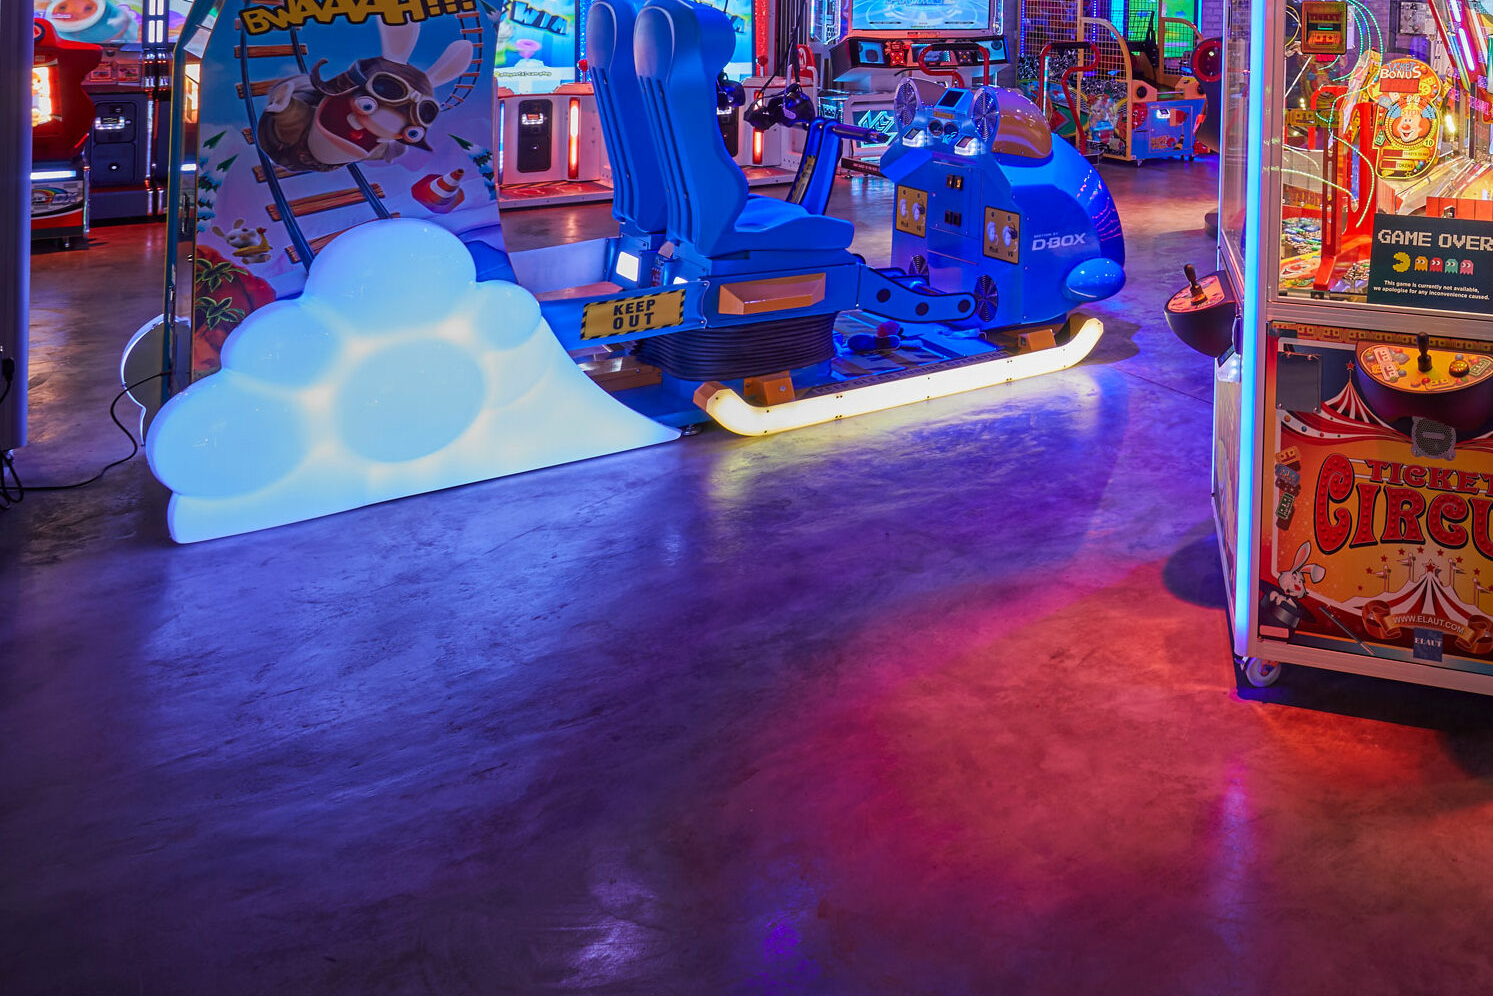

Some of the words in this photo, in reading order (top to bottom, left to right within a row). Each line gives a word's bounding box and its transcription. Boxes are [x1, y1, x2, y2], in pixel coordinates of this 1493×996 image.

[1380, 66, 1422, 79] BONUS
[1378, 229, 1432, 247] GAME
[1438, 233, 1493, 251] OVER
[1382, 286, 1408, 294] apologise
[1429, 290, 1468, 299] inconvenience
[613, 299, 656, 316] KEEP
[613, 312, 655, 330] OUT
[1393, 615, 1465, 635] WWW.ELAUT.COM
[1414, 637, 1441, 647] ELAUT
